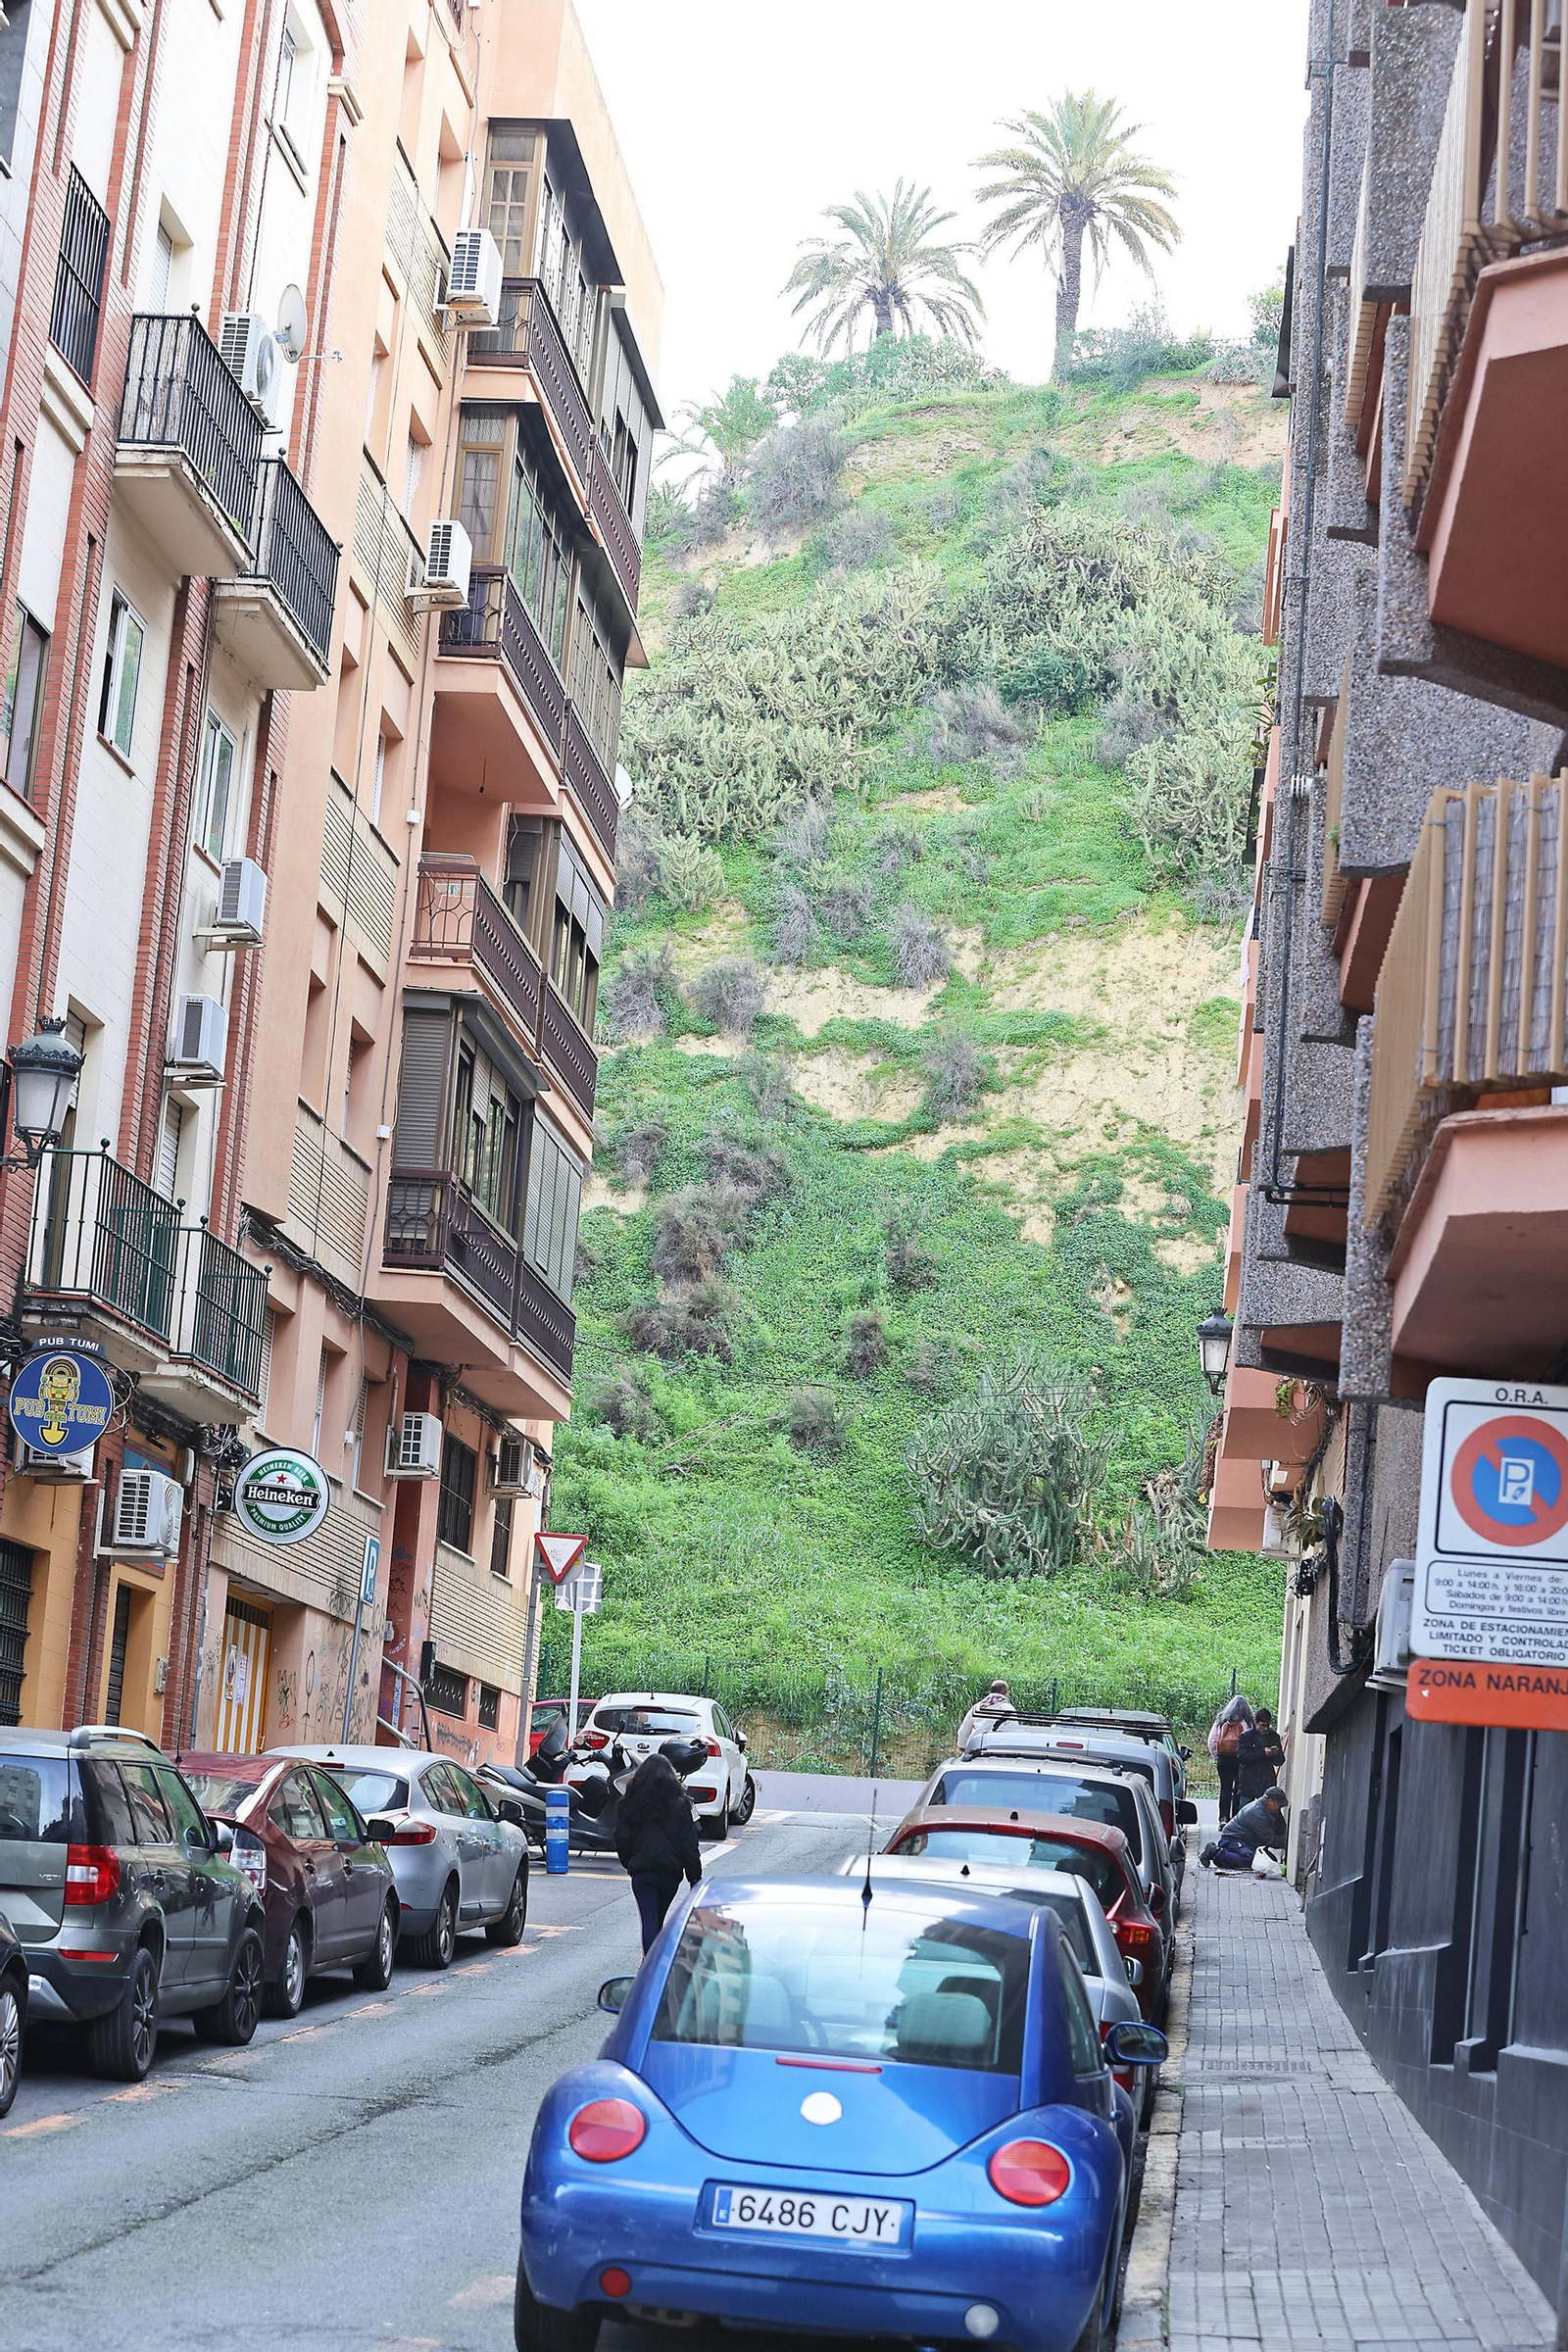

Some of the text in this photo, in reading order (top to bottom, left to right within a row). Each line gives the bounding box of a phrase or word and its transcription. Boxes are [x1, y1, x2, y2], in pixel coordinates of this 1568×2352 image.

[39, 1337, 99, 1351] PUB TUMI
[1494, 1388, 1548, 1404] O.R.A.
[14, 1396, 107, 1425] PUB TUMI
[257, 1461, 310, 1482] HEINEKEN BEER
[1502, 1461, 1530, 1496] P
[247, 1486, 313, 1506] Heineken
[250, 1507, 306, 1531] PREMIUM QUALITY
[1434, 1578, 1453, 1587] 9:00
[1457, 1569, 1488, 1579] Lunes
[1505, 1571, 1543, 1583] Viernes
[1490, 1592, 1501, 1601] de
[1504, 1593, 1524, 1603] 9:00
[1448, 1600, 1495, 1613] Domingos
[1507, 1604, 1543, 1615] festivos
[1546, 1606, 1566, 1616] libre
[1423, 1618, 1454, 1629] ZONA
[1460, 1620, 1477, 1631] DE
[1429, 1631, 1483, 1642] LIMITADO
[1489, 1635, 1495, 1643] Y
[1443, 1643, 1566, 1661] TICKET OBLIGATORIO
[1418, 1669, 1476, 1689] ZONA
[718, 2195, 890, 2236] E 6486 CJY
